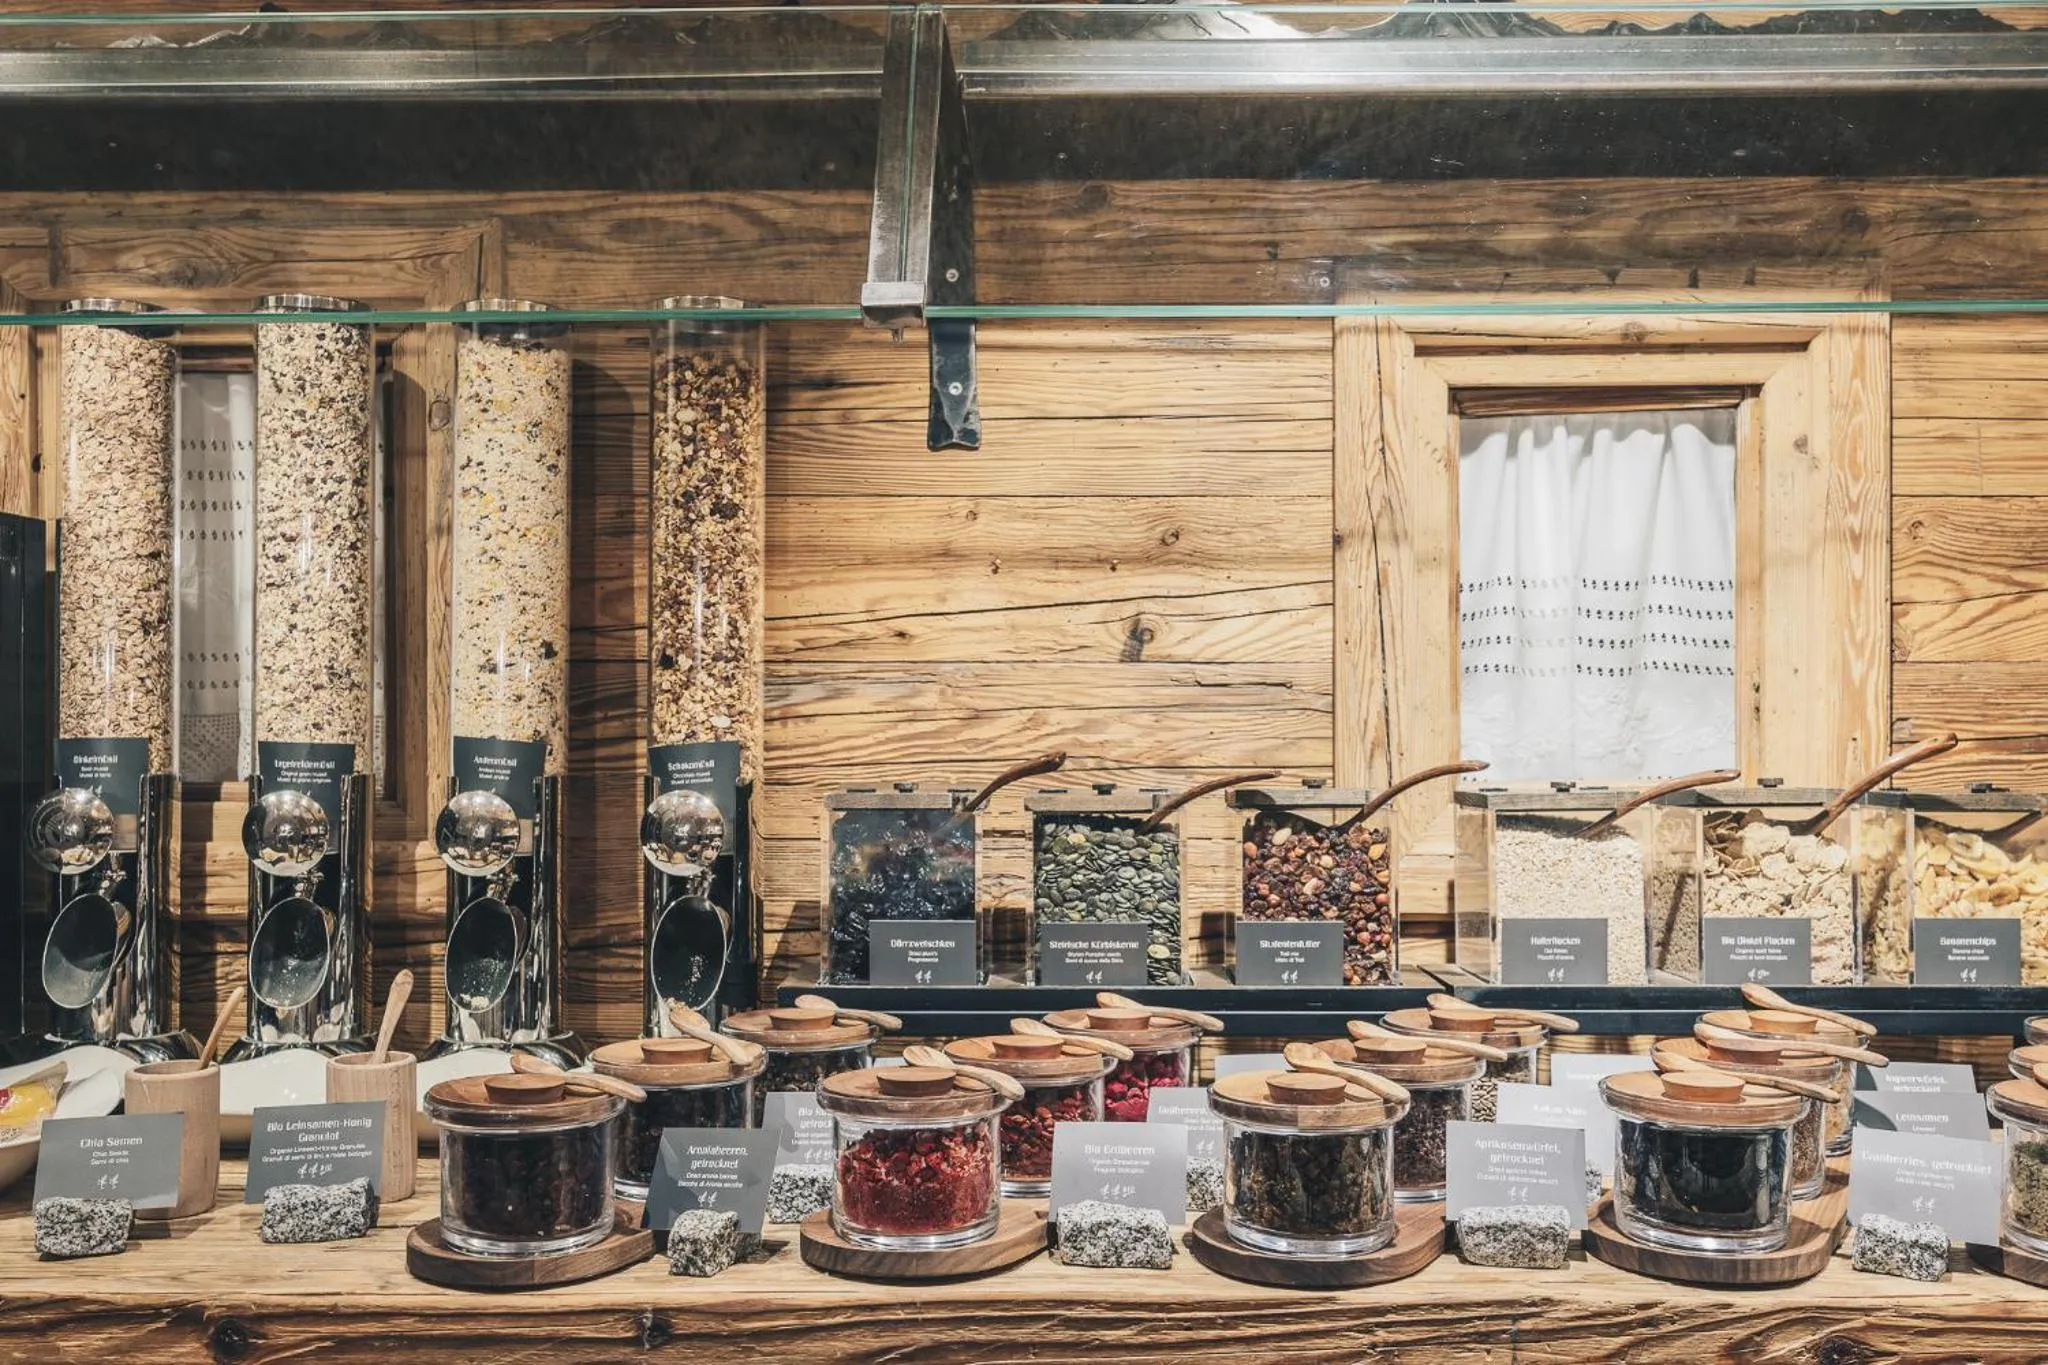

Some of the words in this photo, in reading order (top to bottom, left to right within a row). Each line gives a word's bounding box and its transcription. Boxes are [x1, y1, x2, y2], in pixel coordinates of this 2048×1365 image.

[267, 1121, 283, 1133] Bio
[80, 1136, 103, 1149] Chia
[106, 1136, 143, 1147] Samen
